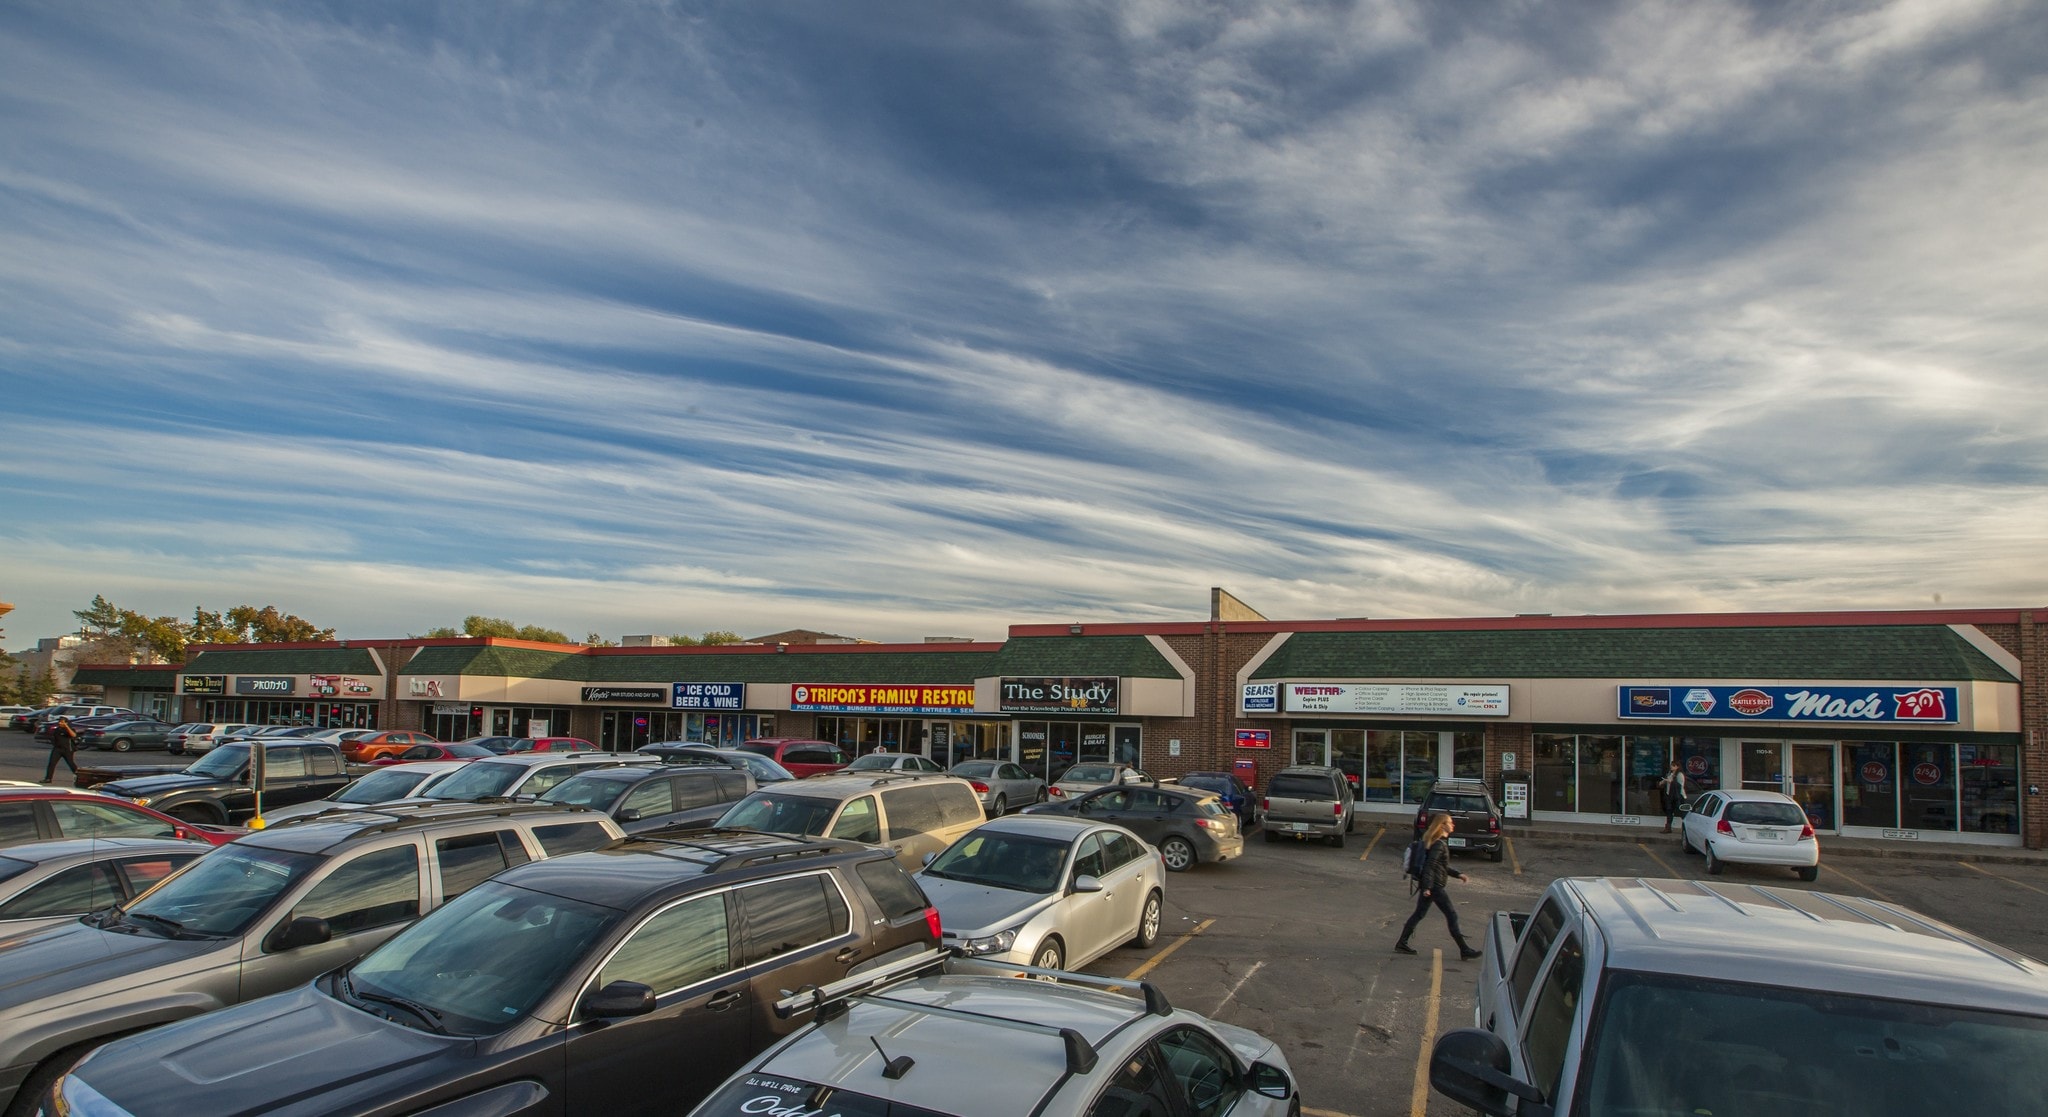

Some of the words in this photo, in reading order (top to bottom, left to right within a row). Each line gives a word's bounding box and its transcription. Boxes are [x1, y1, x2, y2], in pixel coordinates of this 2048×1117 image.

[686, 685, 703, 695] ICE
[704, 685, 731, 696] COLD
[810, 688, 866, 703] TRIFON'S
[870, 689, 918, 704] FAMILY
[922, 689, 974, 705] RESTAU
[1004, 684, 1044, 699] The
[1050, 684, 1112, 703] Study
[1245, 686, 1275, 696] SEARS
[675, 696, 701, 707] BEER
[702, 696, 710, 707] &
[713, 697, 739, 708] WINE
[1784, 690, 1885, 718] Mac's
[1737, 706, 1764, 714] COFFEE
[745, 1077, 758, 1086] ALL
[760, 1080, 779, 1089] WE'LL
[780, 1083, 802, 1094] DRIVE
